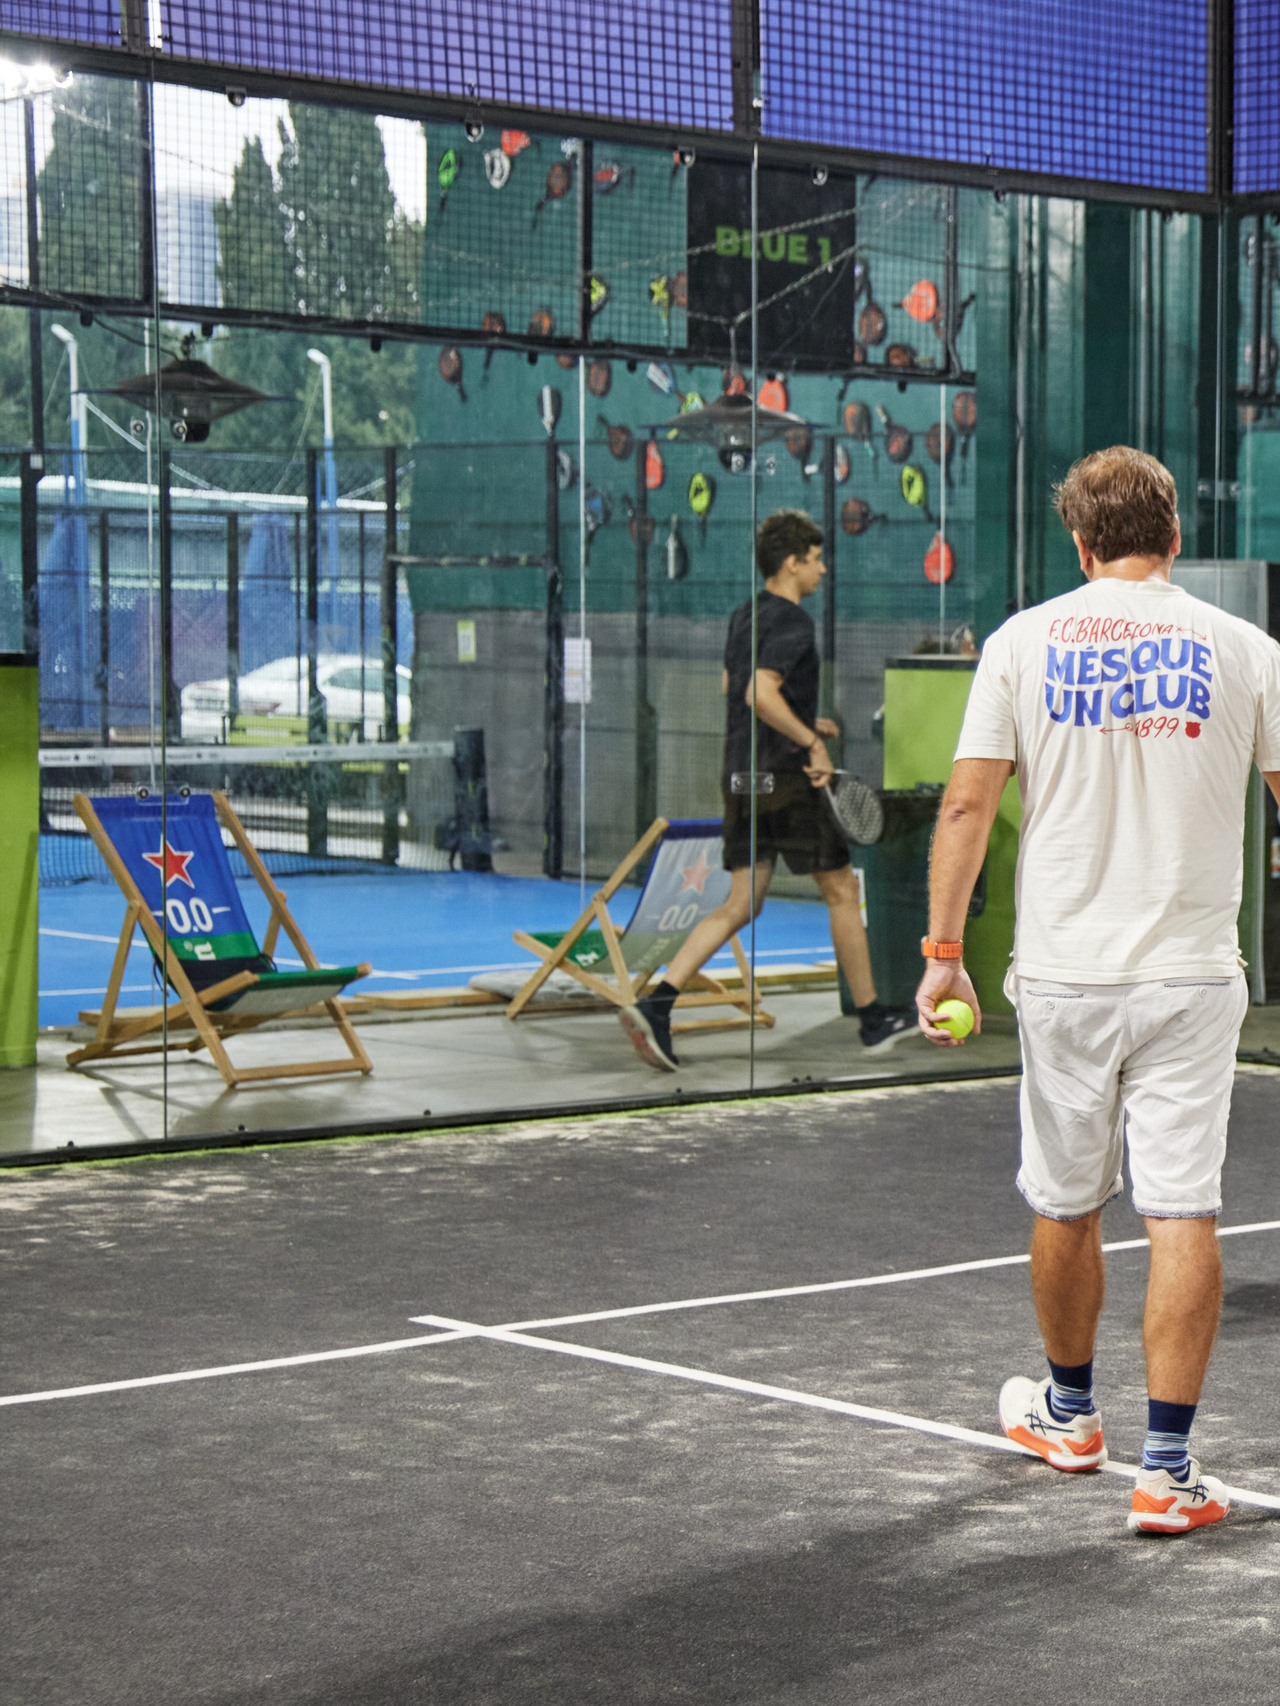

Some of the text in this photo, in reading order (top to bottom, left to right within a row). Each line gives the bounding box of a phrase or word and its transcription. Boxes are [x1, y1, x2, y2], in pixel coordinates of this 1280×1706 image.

[715, 225, 831, 264] BLUE 1
[1045, 674, 1211, 727] UN CLUB
[1135, 716, 1180, 739] 1899
